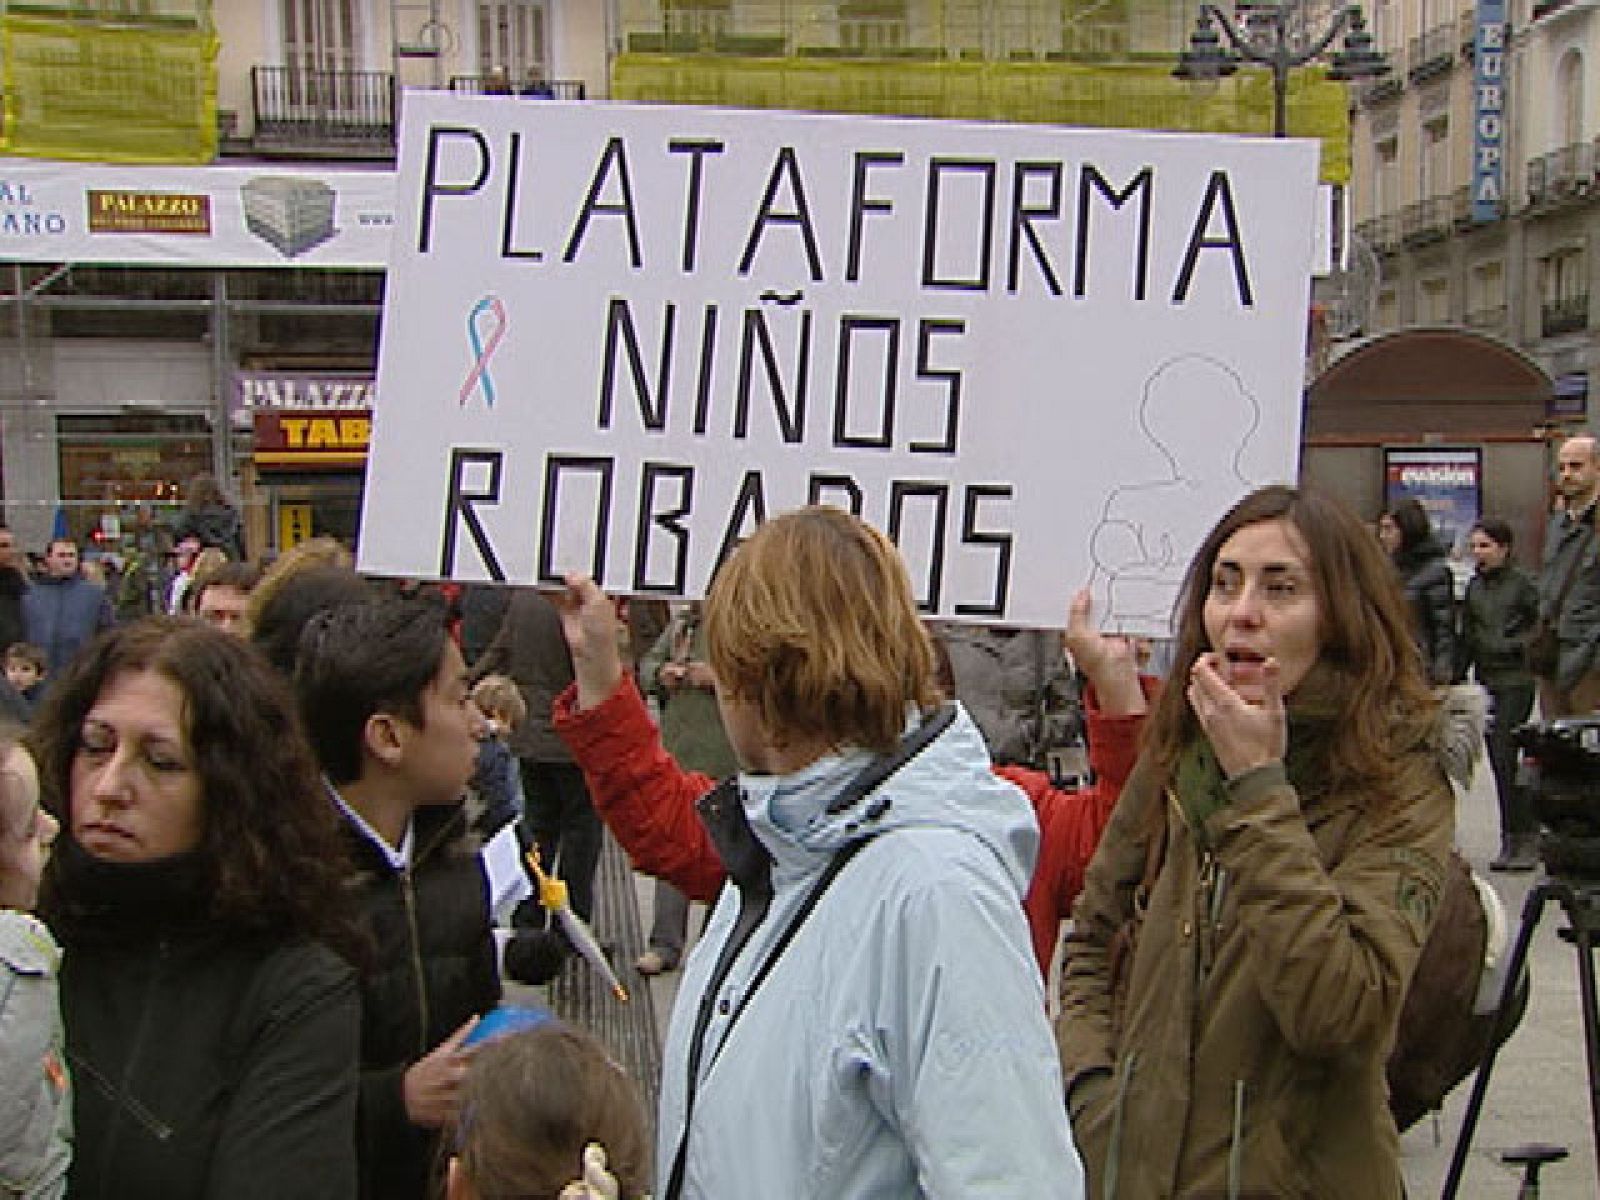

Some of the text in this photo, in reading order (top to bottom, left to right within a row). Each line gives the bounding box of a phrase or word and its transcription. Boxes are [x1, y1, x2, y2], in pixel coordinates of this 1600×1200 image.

[1479, 24, 1503, 201] EUROPA
[100, 194, 199, 216] PALAZZO
[418, 124, 1254, 307] PLATAFORMA
[599, 290, 966, 454] NIÑOS
[440, 448, 1014, 616] ROBAOS
